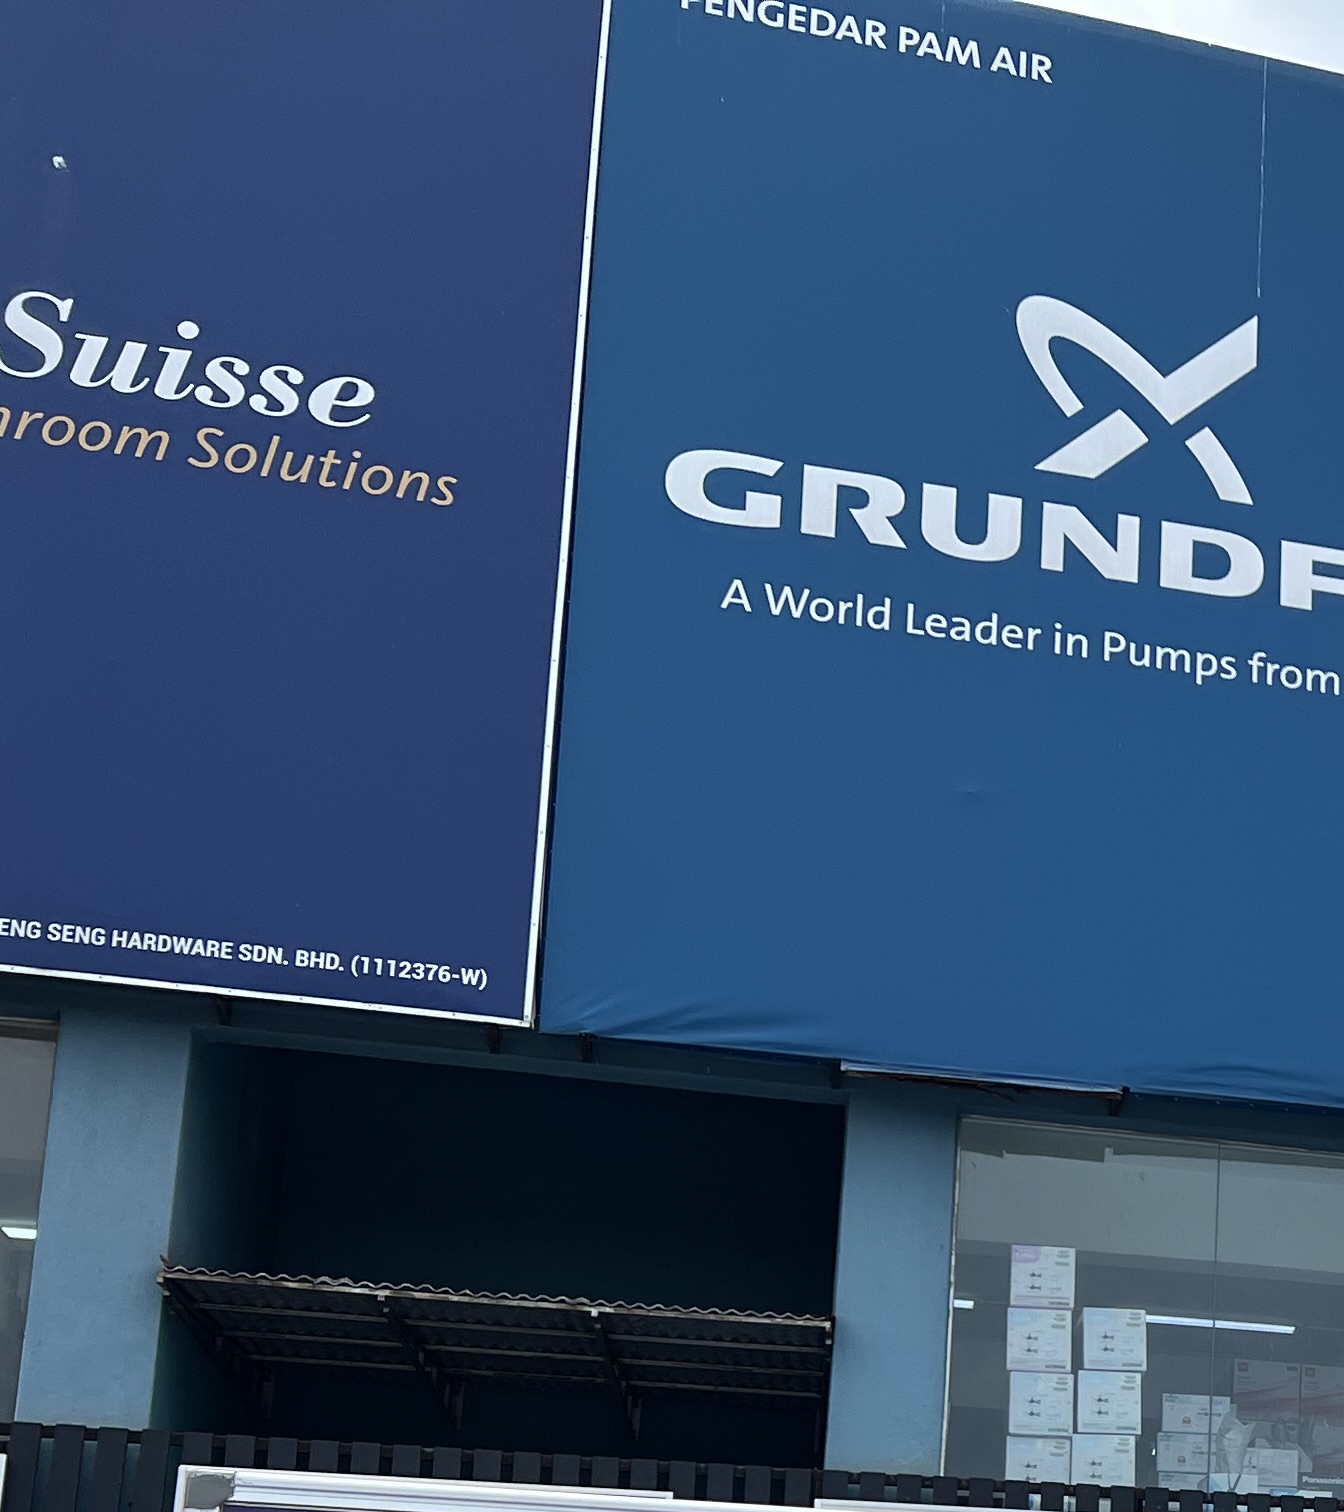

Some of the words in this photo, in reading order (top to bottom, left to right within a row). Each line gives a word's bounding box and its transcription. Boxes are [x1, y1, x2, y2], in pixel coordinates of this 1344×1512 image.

[899, 26, 980, 69] PAM
[991, 47, 1053, 84] AIR
[0, 290, 376, 429] Suisse
[187, 427, 459, 507] Solutions
[720, 578, 753, 611] A
[765, 584, 892, 633] World
[906, 601, 1041, 654] Leader
[1053, 622, 1089, 658] in
[1102, 631, 1237, 684] Pumps
[1247, 650, 1341, 697] from
[47, 923, 106, 946] SENG
[111, 929, 234, 961] HARDWARE
[238, 943, 289, 966] SDN.
[295, 949, 345, 971] BHD.
[350, 954, 489, 991] (1112376-W)
[1302, 1476, 1344, 1486] Panasonic
